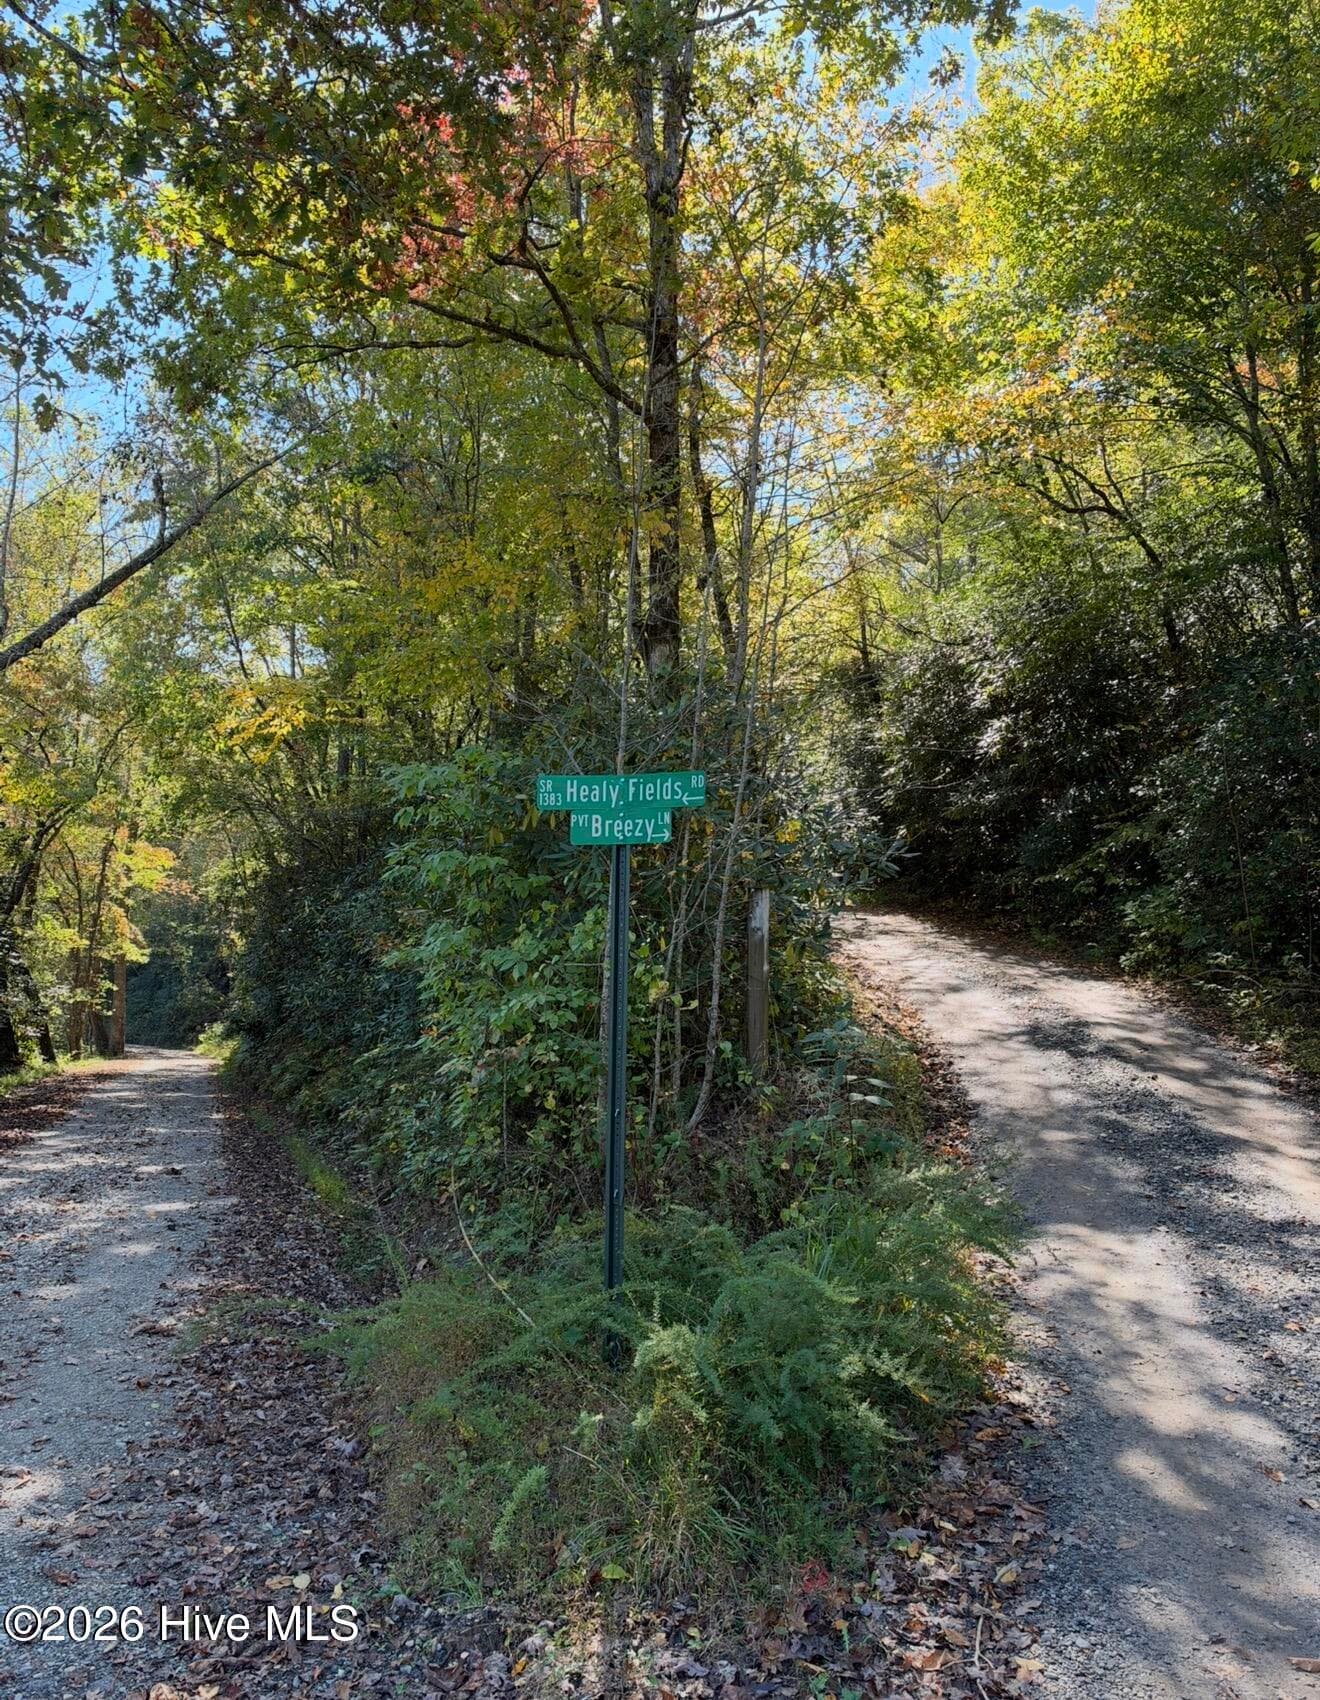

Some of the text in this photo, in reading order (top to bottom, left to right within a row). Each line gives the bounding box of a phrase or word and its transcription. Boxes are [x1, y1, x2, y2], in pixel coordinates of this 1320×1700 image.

[539, 780, 553, 793] SR
[566, 775, 704, 808] Healy Fields RD
[539, 792, 562, 806] 1383
[571, 812, 670, 842] PVT Breezy LN
